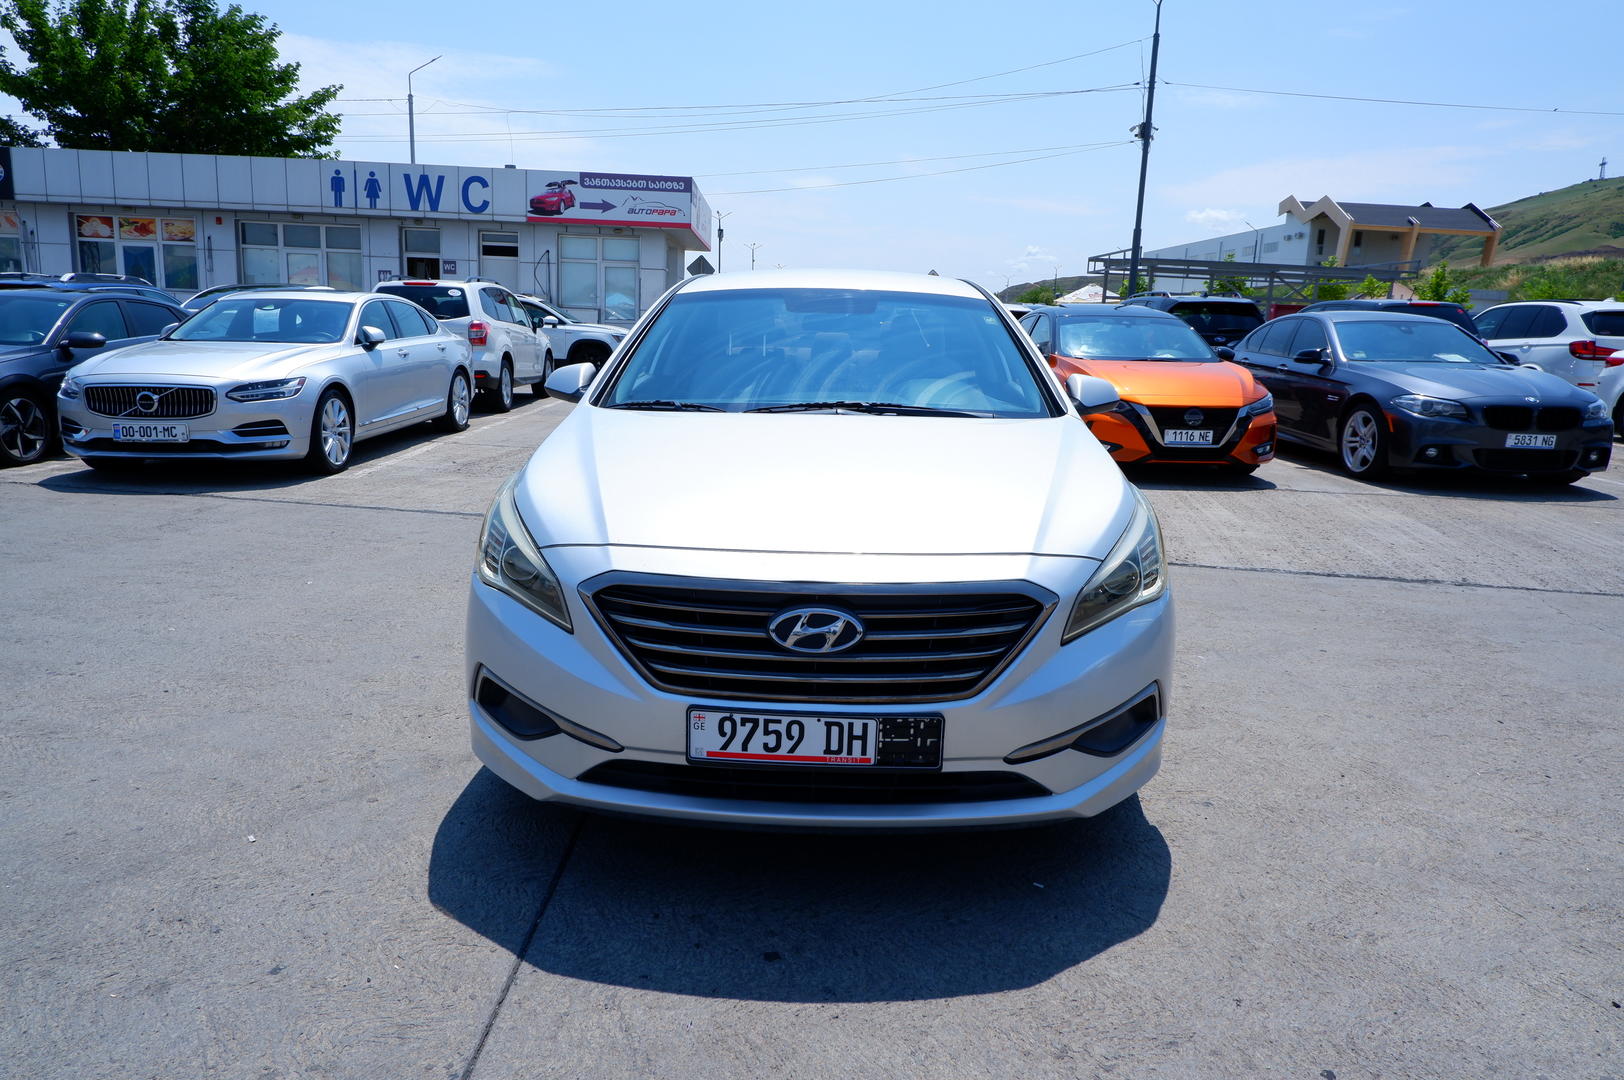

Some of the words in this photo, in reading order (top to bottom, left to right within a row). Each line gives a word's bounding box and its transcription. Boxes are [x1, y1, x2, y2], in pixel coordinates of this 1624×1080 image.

[648, 180, 685, 190] საიტზე
[443, 263, 456, 271] WC
[1172, 431, 1195, 442] 1116
[1198, 431, 1211, 442] NE
[1513, 434, 1538, 446] 5831
[1541, 436, 1554, 447] NG
[693, 721, 705, 731] GE
[718, 715, 805, 754] 9759
[823, 721, 869, 756] DH
[826, 756, 861, 764] TRANSIT
